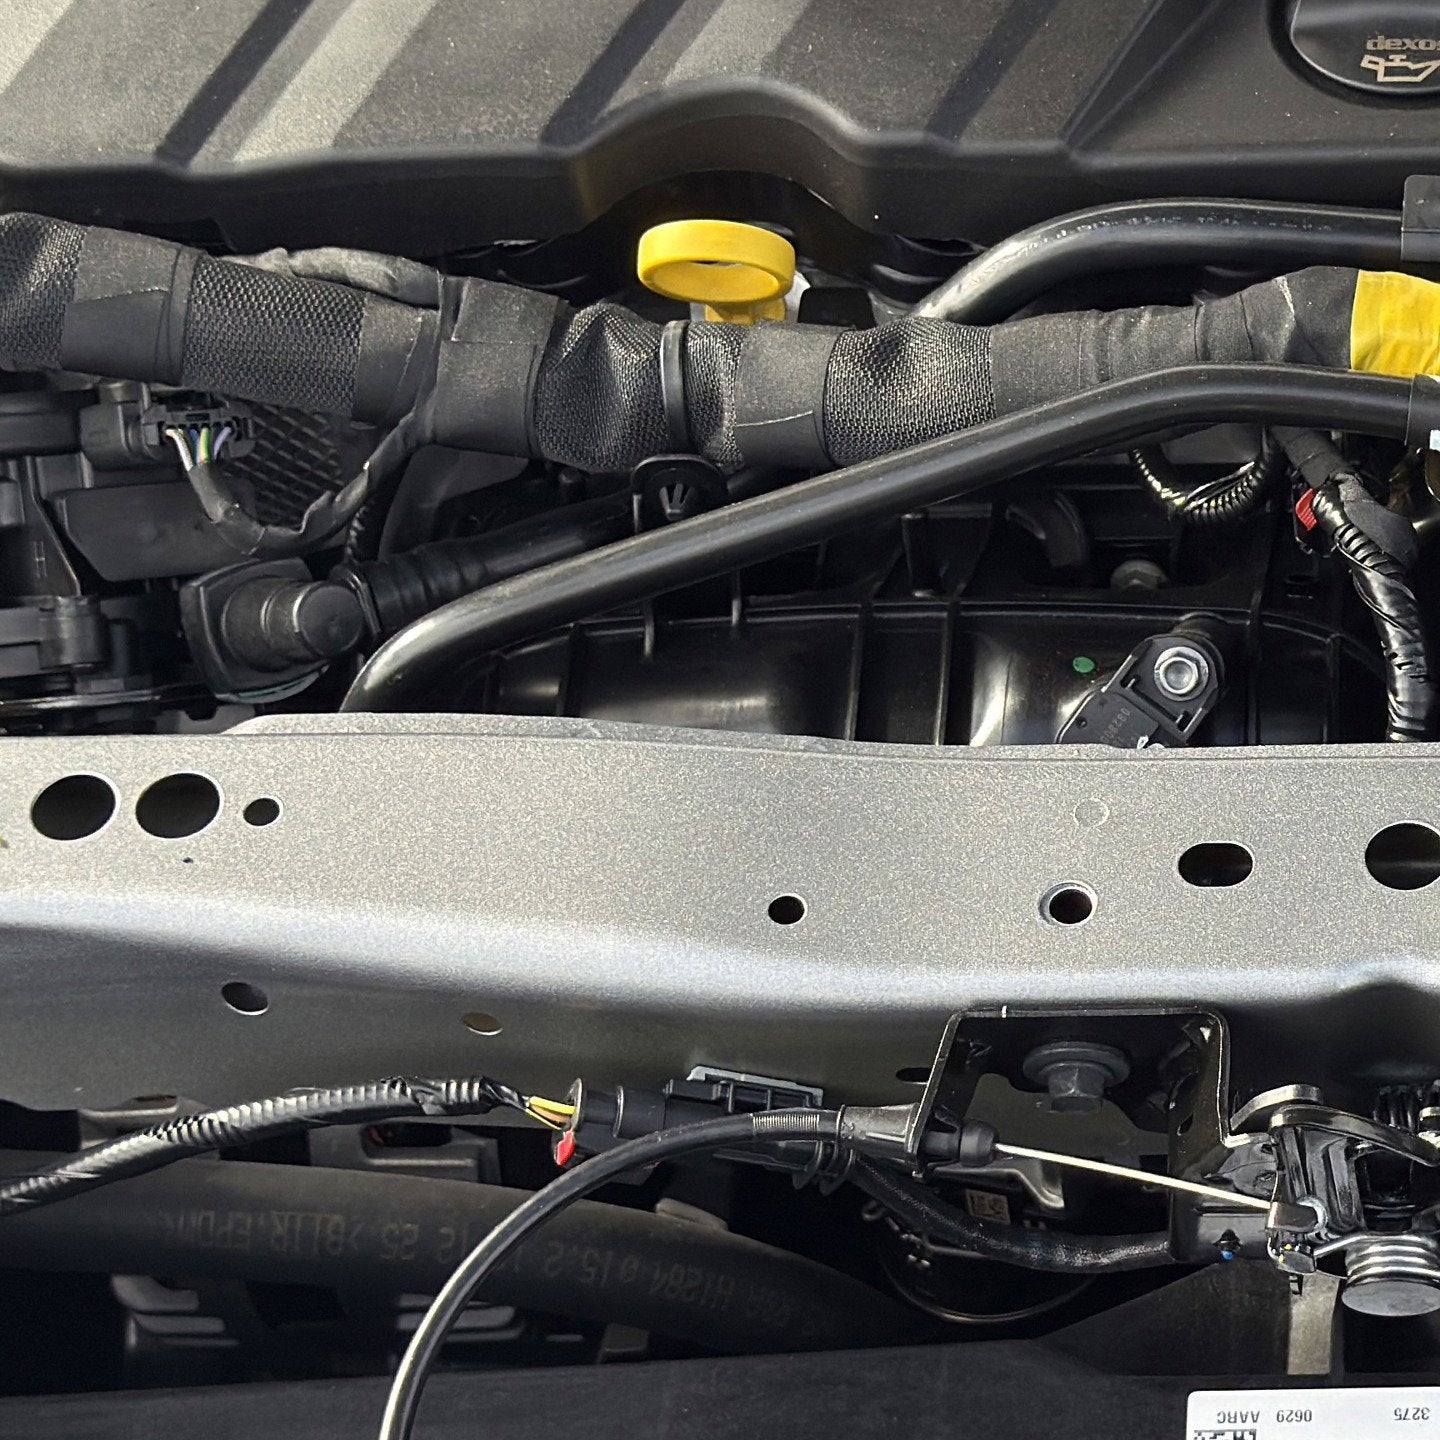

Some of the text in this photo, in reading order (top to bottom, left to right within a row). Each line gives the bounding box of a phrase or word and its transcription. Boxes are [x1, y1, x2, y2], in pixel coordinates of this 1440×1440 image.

[1216, 1407, 1431, 1424] 3275 0629 AARC
